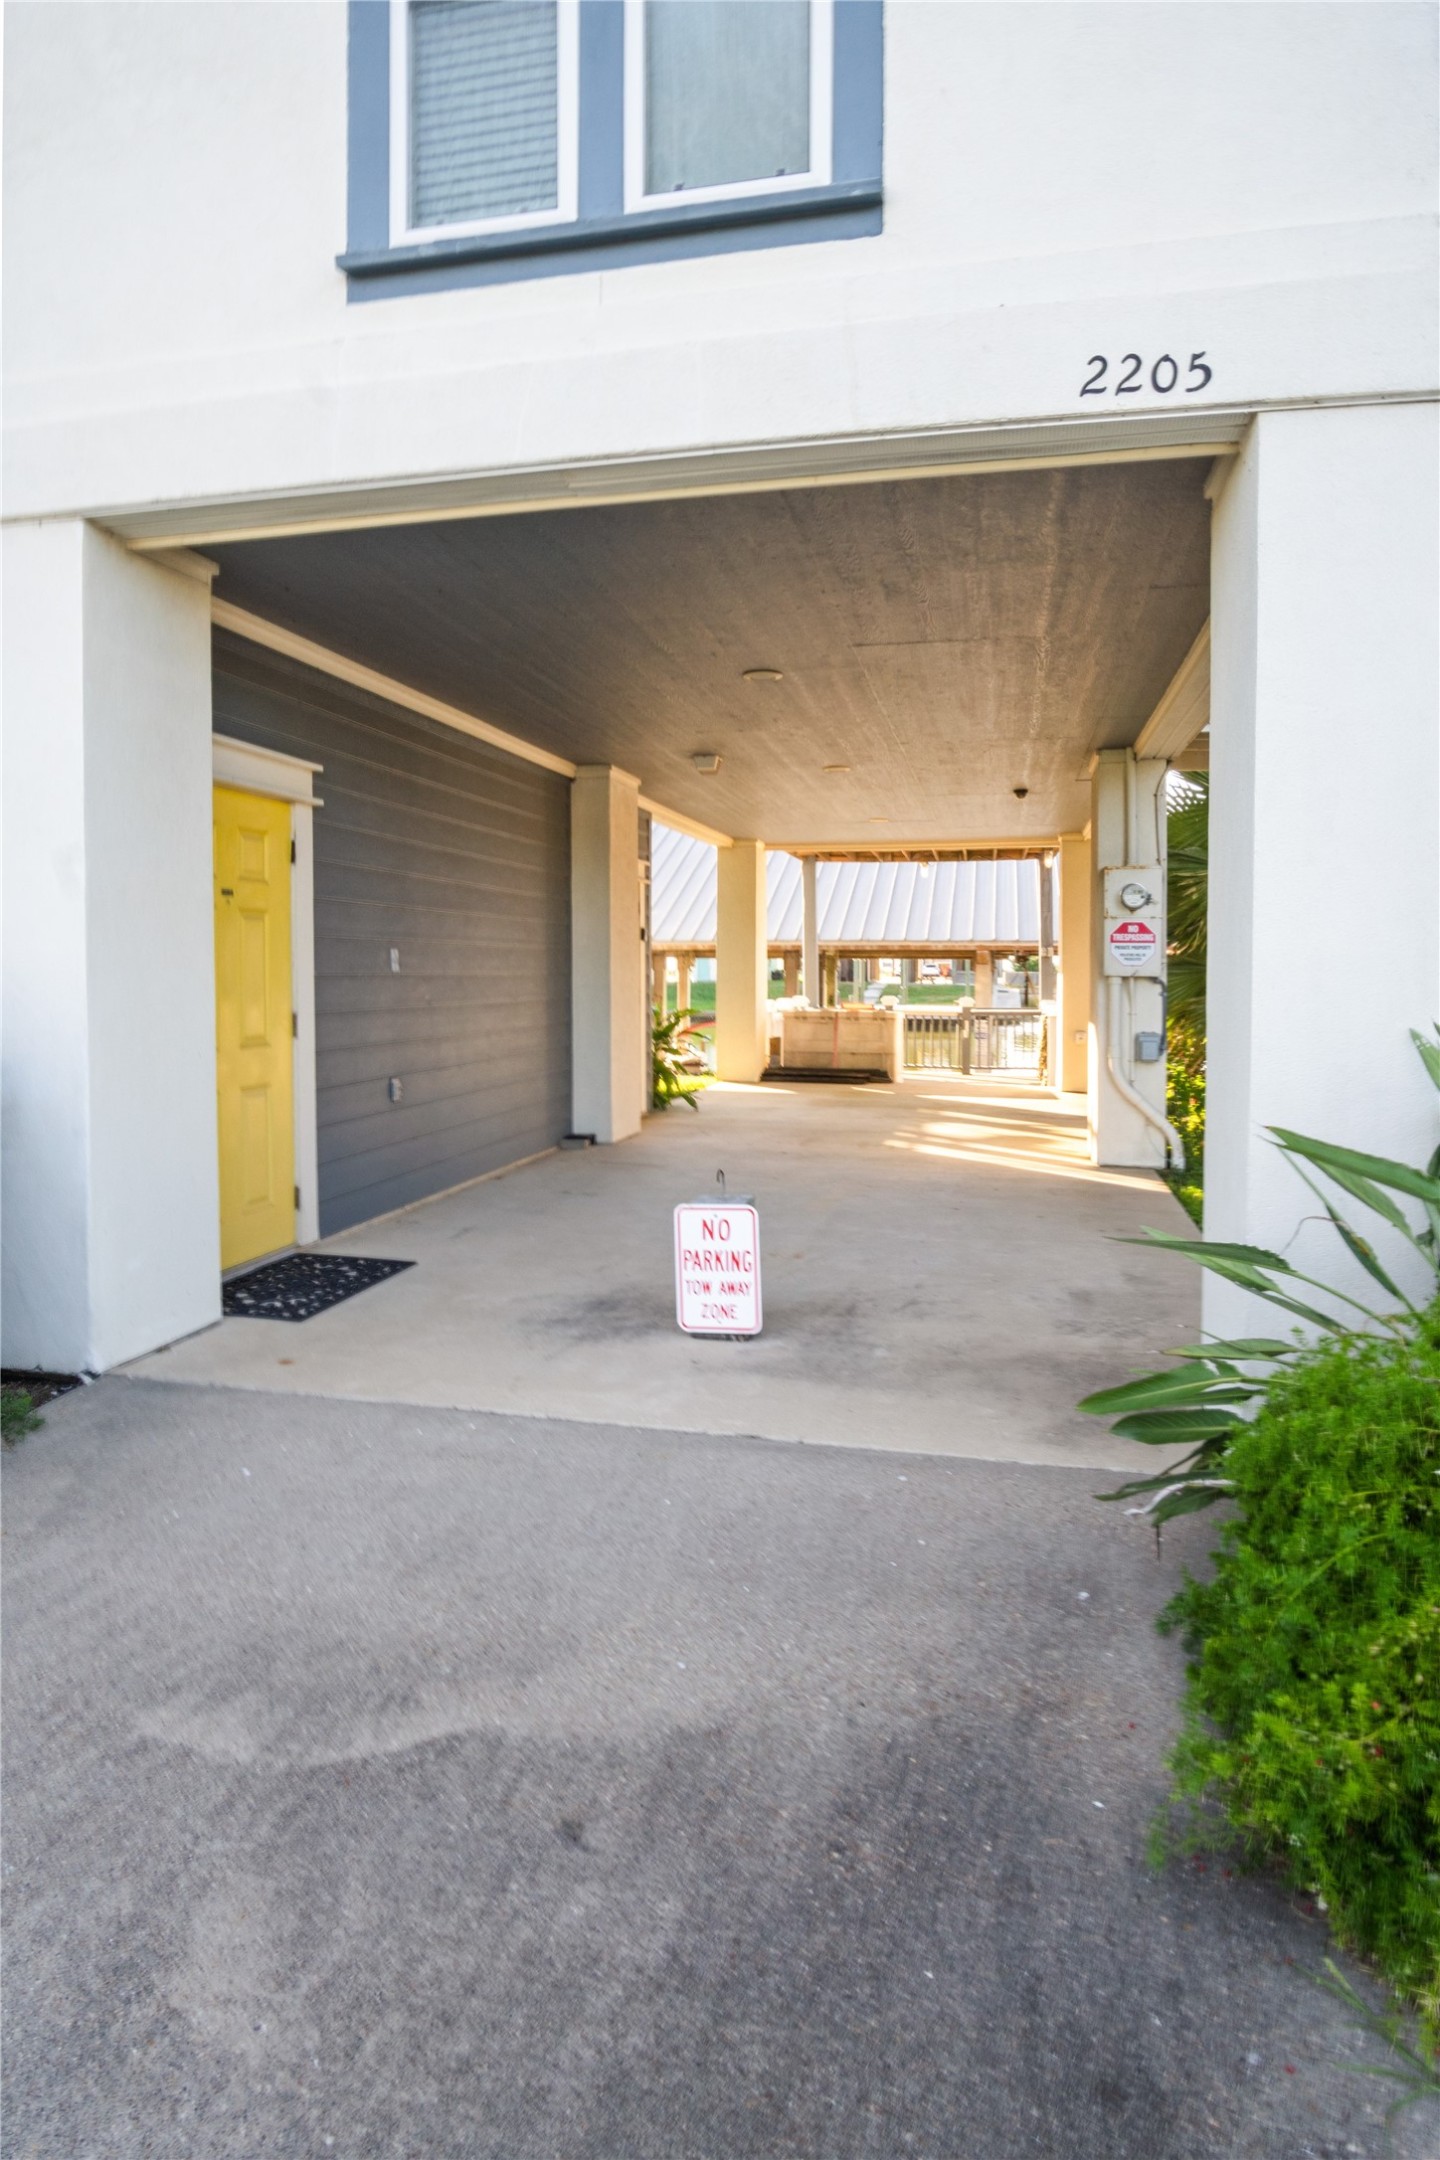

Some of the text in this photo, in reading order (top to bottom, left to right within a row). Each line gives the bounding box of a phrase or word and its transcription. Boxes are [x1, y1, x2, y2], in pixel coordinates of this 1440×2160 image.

[1079, 351, 1213, 397] 2205
[1127, 925, 1139, 933] NO
[702, 1218, 731, 1241] NO
[683, 1249, 752, 1273] PARKING
[684, 1279, 752, 1296] TOW AWAY
[701, 1303, 738, 1320] ZONE
